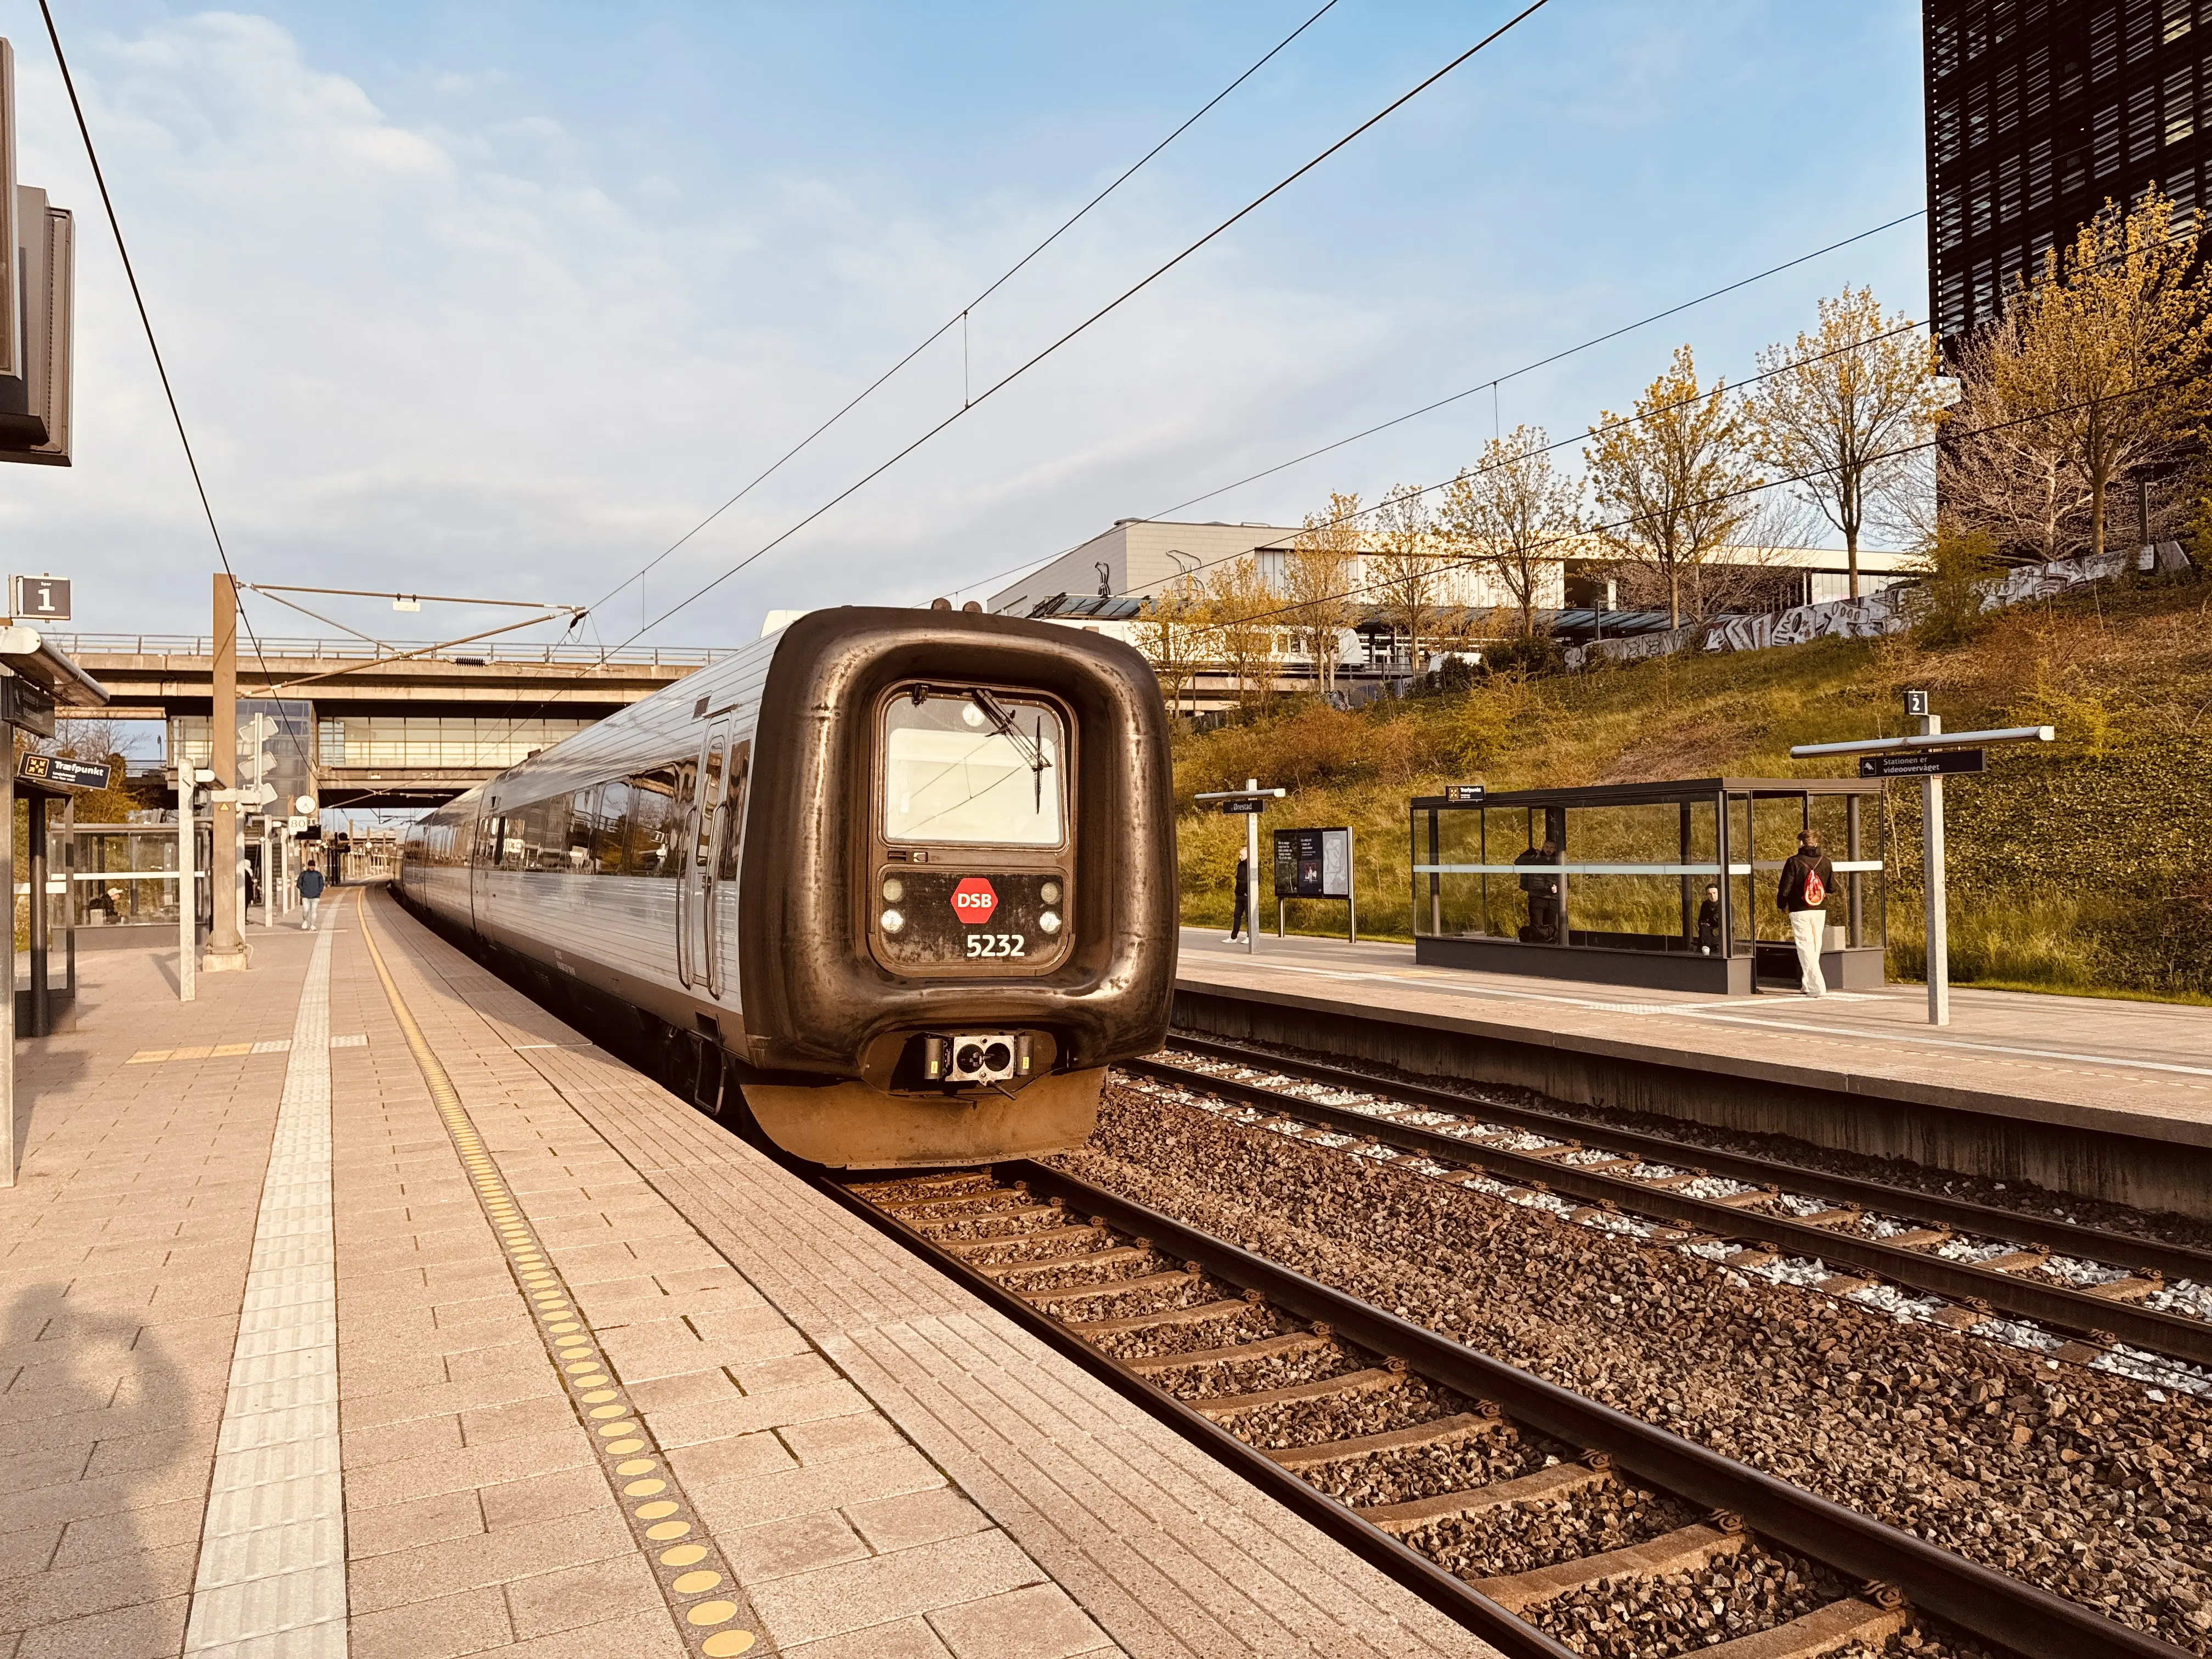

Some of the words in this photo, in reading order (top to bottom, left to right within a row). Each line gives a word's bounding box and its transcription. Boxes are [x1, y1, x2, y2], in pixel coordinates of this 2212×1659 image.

[38, 588, 55, 611] 1
[1912, 698, 1920, 710] 2
[54, 761, 104, 776] Træfpunkt
[1883, 764, 1940, 774] videoovervåget
[1233, 802, 1252, 810] Ørestad
[291, 820, 306, 828] 80
[957, 893, 992, 908] DSB
[967, 934, 1025, 957] 5232
